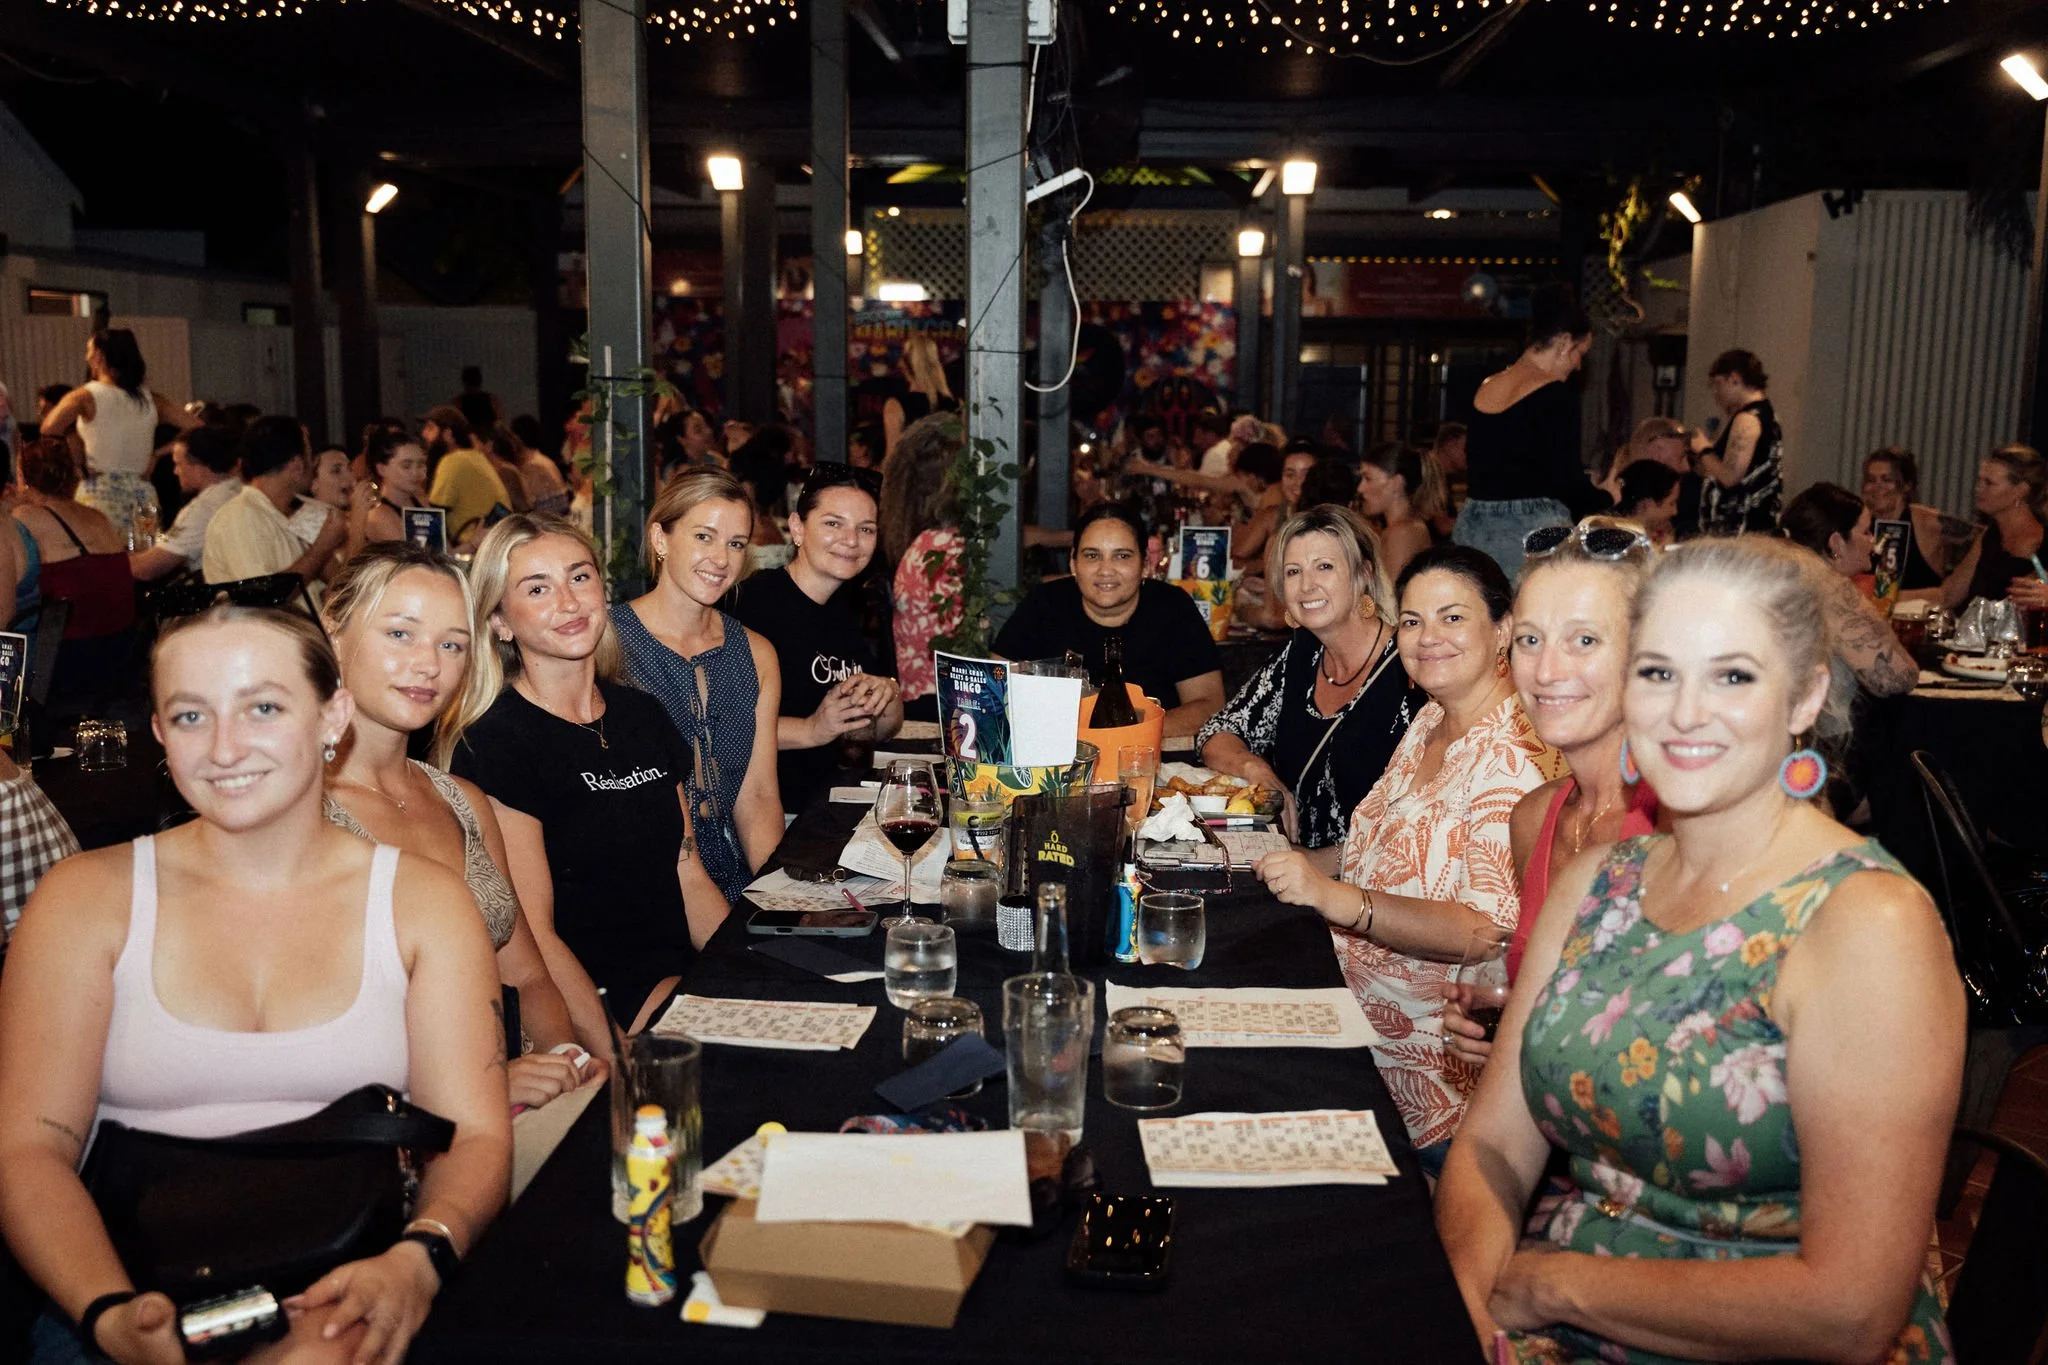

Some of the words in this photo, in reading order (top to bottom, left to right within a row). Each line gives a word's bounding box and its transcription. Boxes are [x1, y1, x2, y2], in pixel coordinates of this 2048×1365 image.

[1197, 556, 1210, 578] 6
[1886, 548, 1896, 568] 5
[954, 679, 982, 694] BINGO
[959, 713, 977, 759] 2
[1044, 842, 1068, 853] HARD
[1037, 850, 1075, 868] RATED
